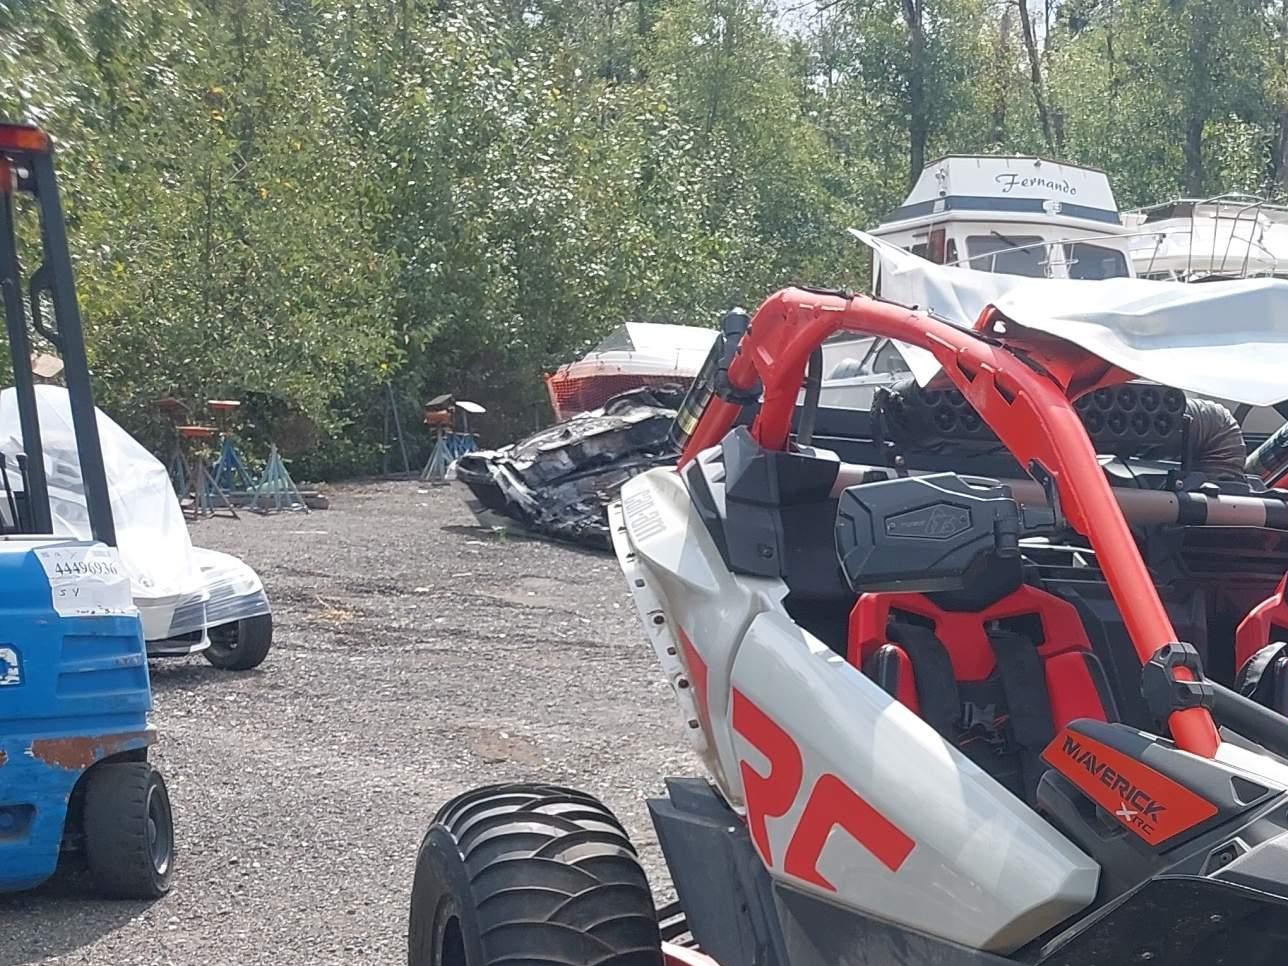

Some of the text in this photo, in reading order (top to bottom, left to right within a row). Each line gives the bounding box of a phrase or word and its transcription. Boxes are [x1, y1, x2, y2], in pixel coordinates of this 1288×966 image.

[994, 172, 1077, 196] Fernando
[55, 561, 118, 576] 44496936
[1062, 735, 1168, 824] MAVERICK
